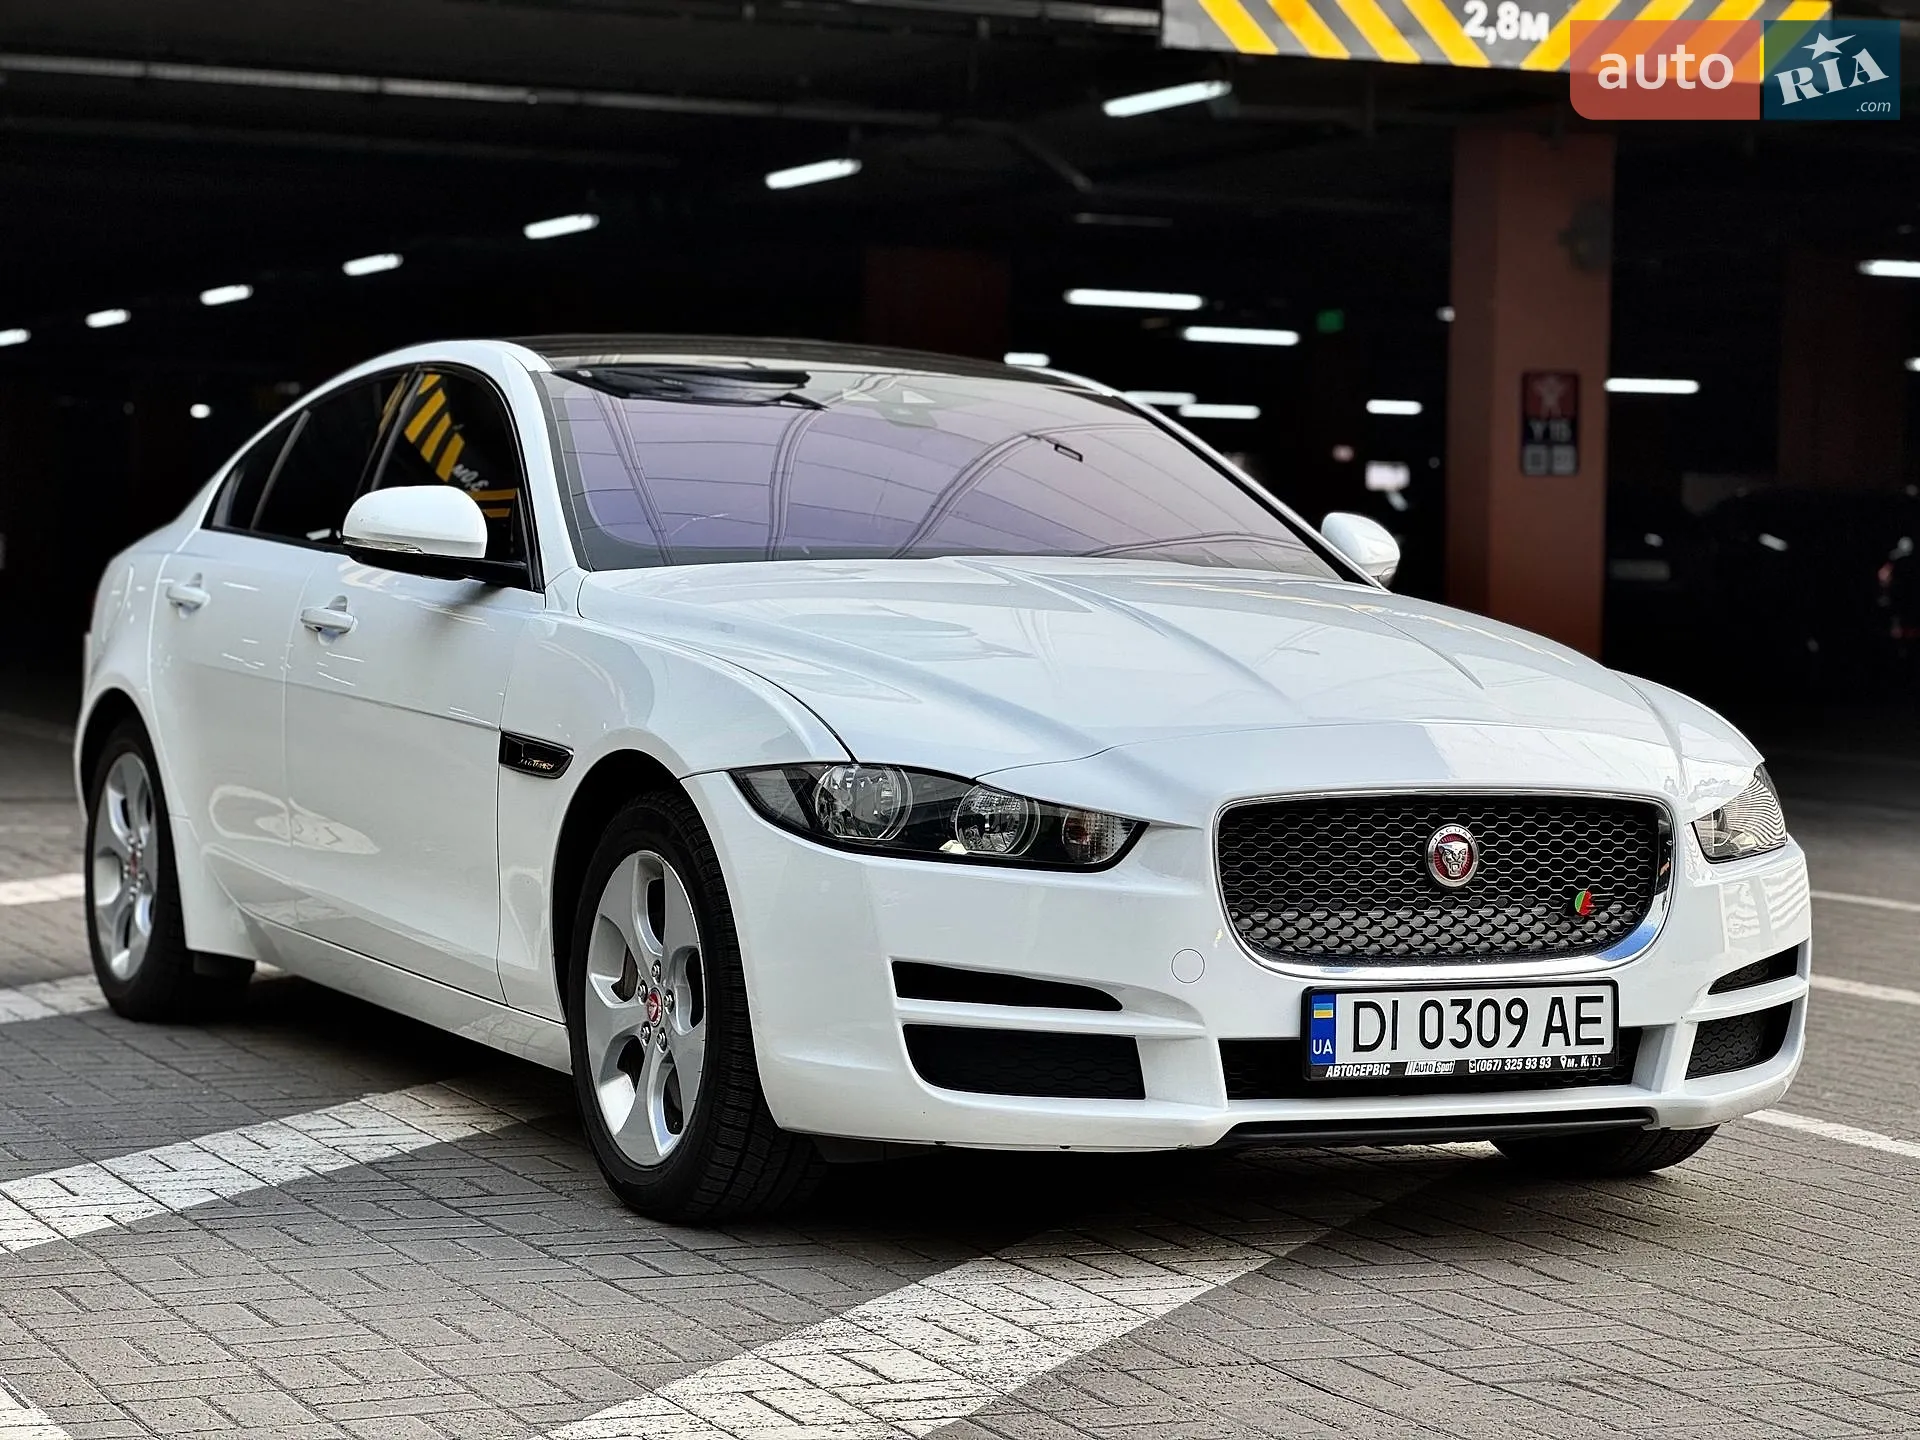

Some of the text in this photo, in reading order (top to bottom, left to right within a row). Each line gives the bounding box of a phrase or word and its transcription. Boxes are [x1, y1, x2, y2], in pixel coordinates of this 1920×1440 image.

[1352, 995, 1605, 1052] DI 0309 AE
[1312, 1039, 1333, 1055] UA
[1325, 1063, 1391, 1078] АВТОСЕРВІС
[1504, 1058, 1523, 1071] 325
[1524, 1057, 1538, 1070] 93
[1539, 1056, 1552, 1069] 93
